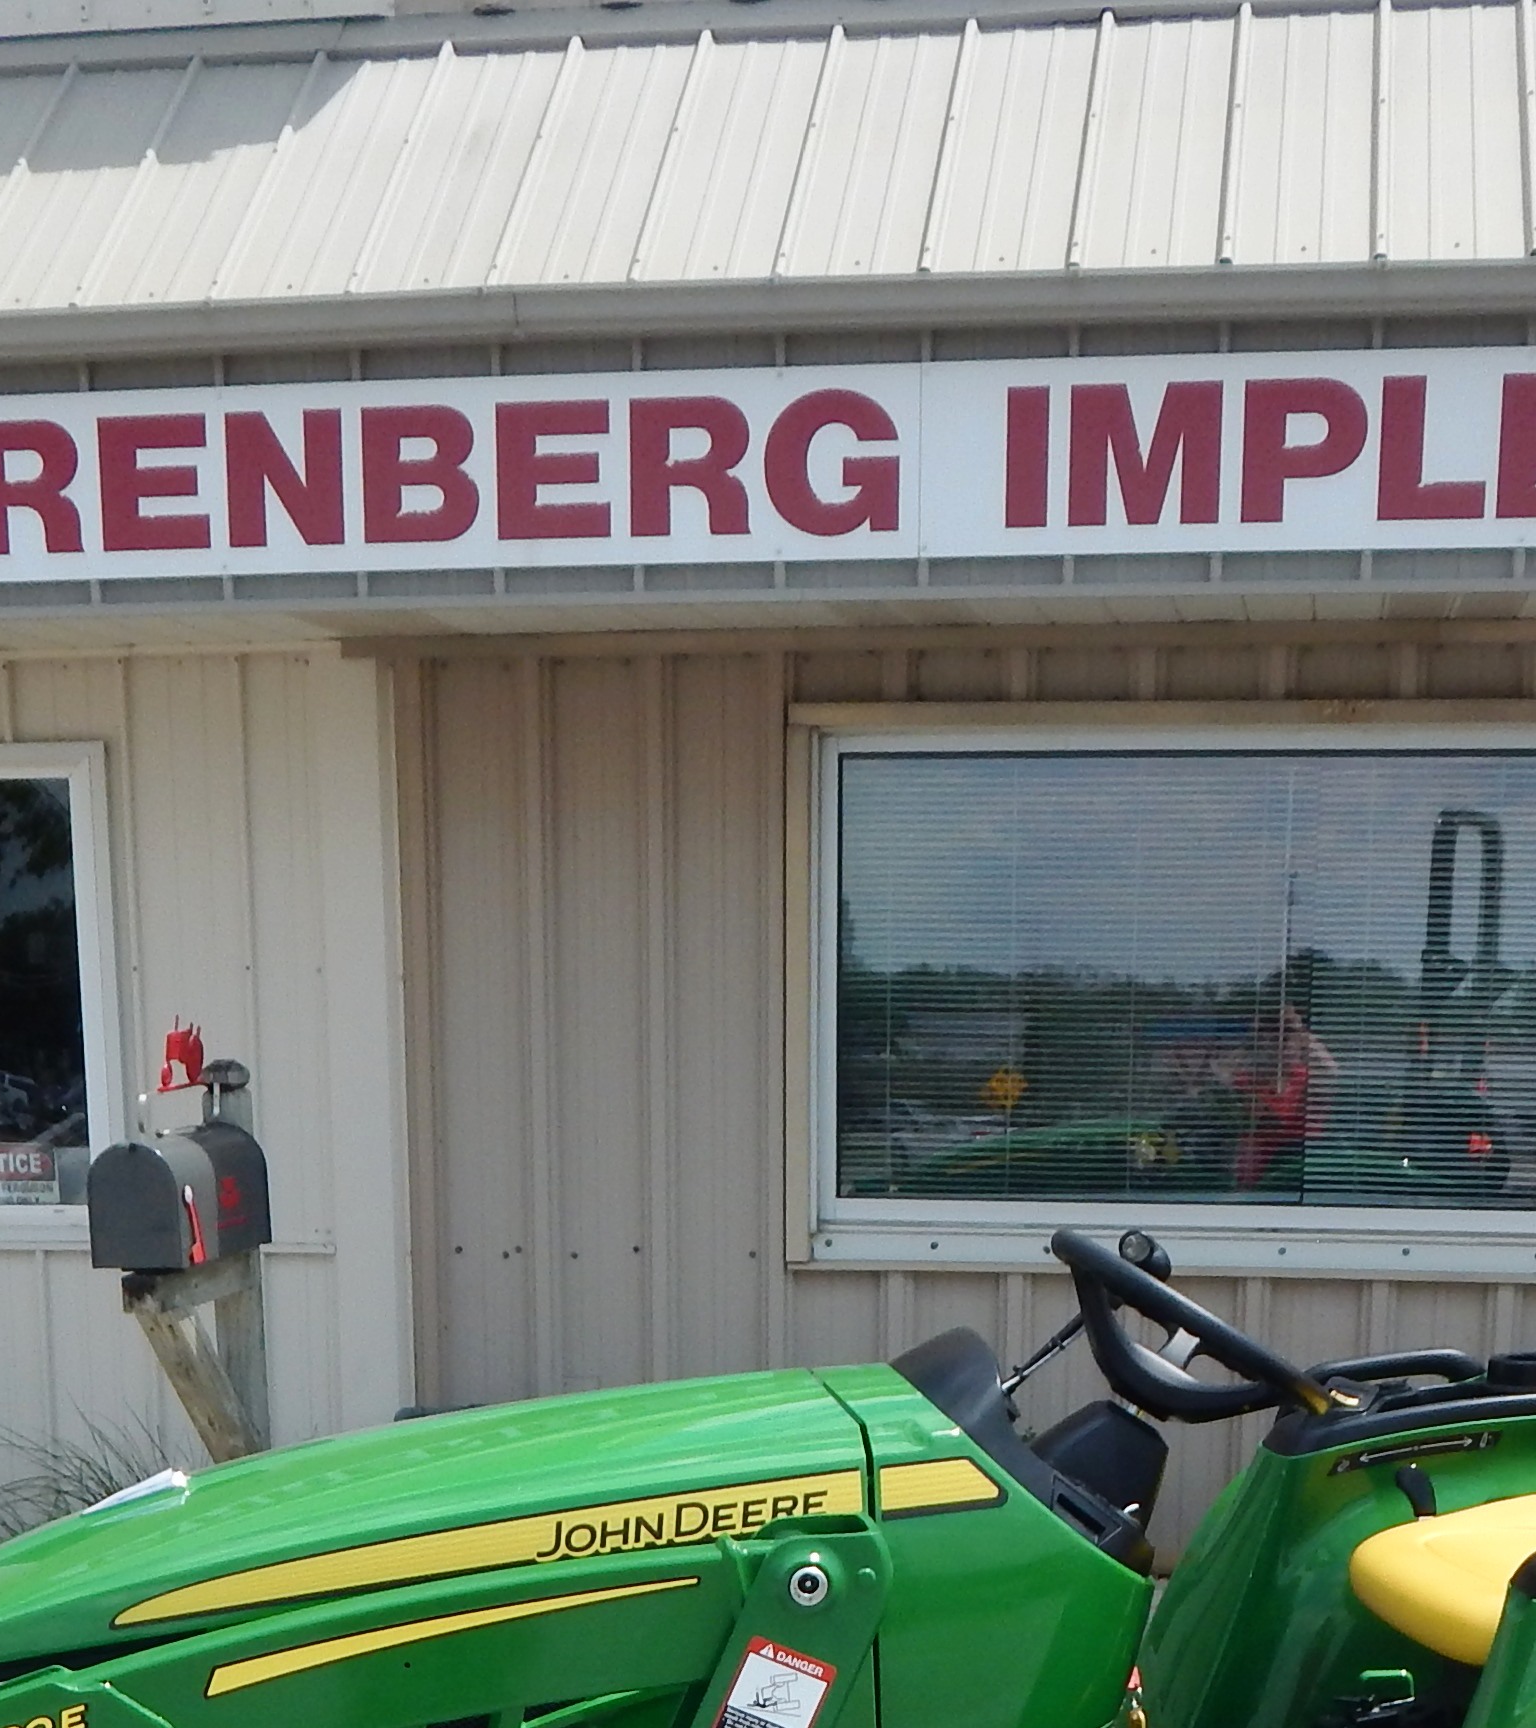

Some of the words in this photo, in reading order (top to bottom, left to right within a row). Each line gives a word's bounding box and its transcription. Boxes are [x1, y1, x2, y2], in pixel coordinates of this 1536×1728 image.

[536, 1512, 664, 1558] JOHN
[674, 1490, 828, 1538] DEERE
[776, 1650, 824, 1678] DANGER
